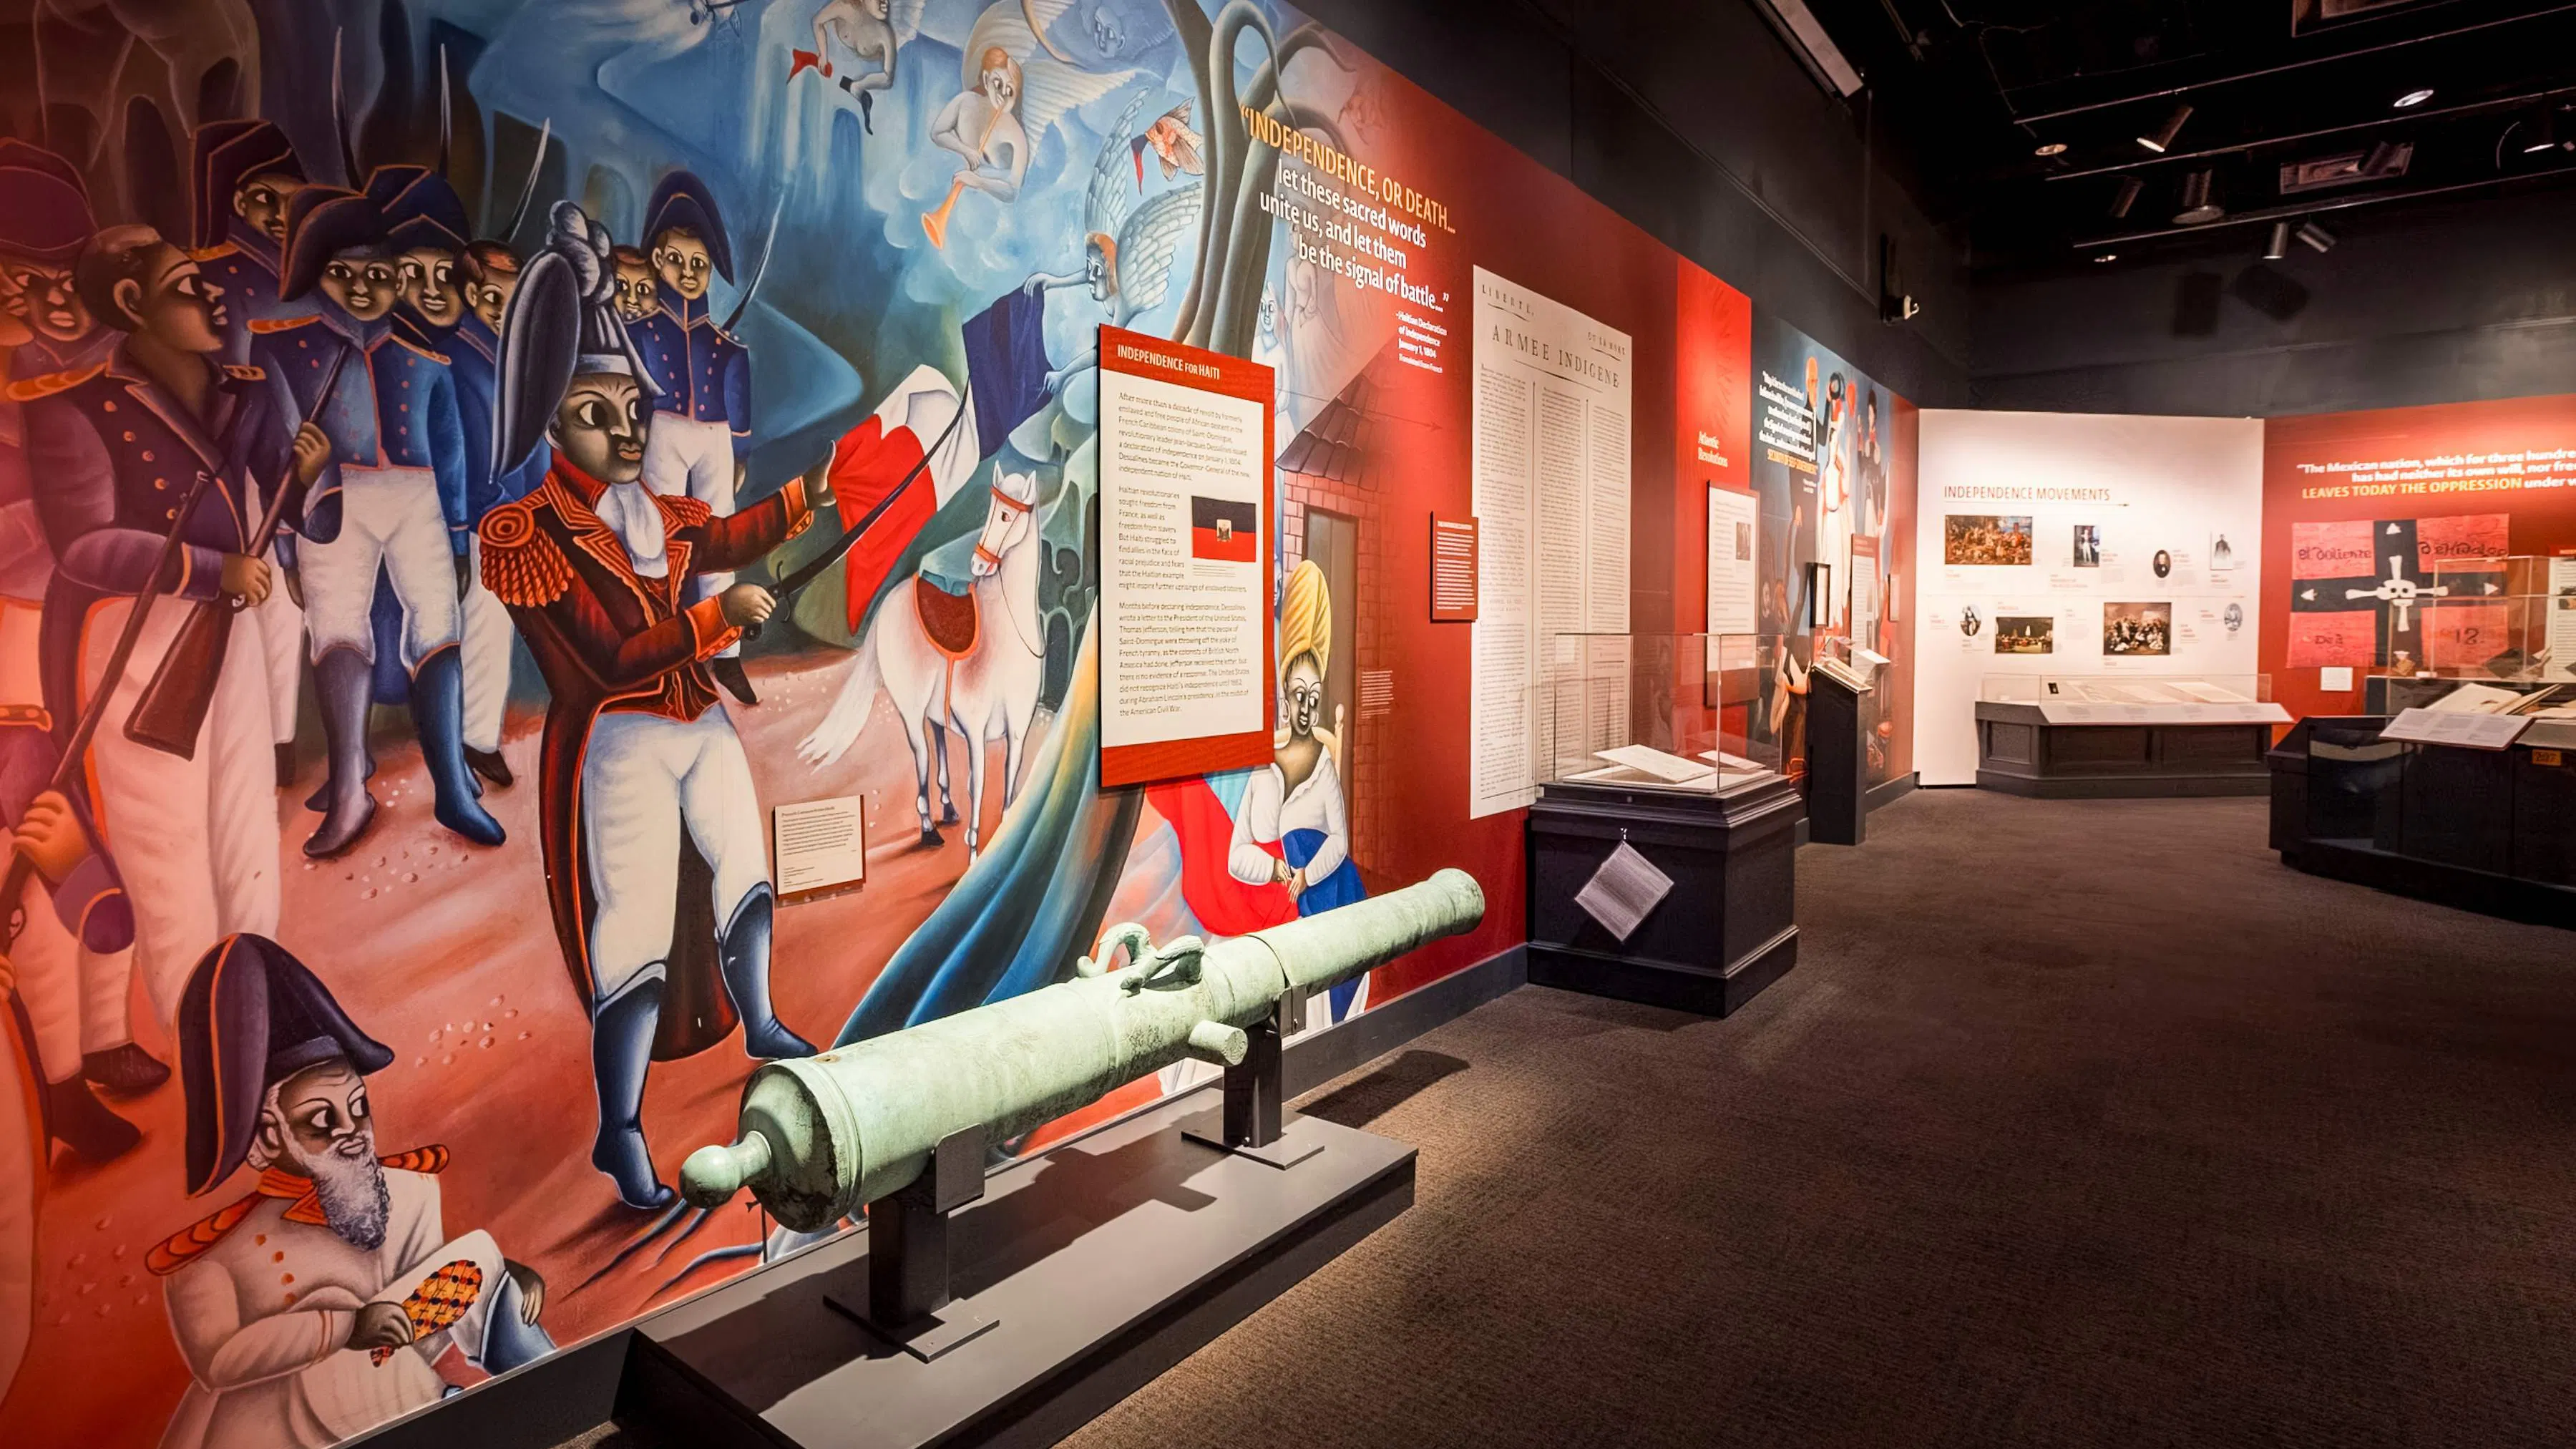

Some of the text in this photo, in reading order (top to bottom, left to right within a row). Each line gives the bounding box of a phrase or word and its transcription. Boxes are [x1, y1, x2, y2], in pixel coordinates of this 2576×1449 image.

[1279, 158, 1427, 248] let these sacred words
[1382, 177, 1403, 209] OR
[1260, 191, 1407, 269] unite us, and let them
[1299, 233, 1317, 264] be
[1319, 245, 1342, 274] the
[1345, 255, 1384, 289] signal
[1385, 273, 1400, 296] of
[1397, 325, 1440, 347] of Independence
[1117, 344, 1220, 380] INDEPENDENCE FOR HAITI
[1697, 447, 1728, 467] Revolutions
[2326, 461, 2379, 473] Mexican
[2379, 458, 2424, 469] nation,
[2424, 455, 2464, 467] which
[2466, 454, 2486, 464] for
[2487, 452, 2524, 463] three
[2351, 472, 2373, 482] has
[2374, 470, 2398, 482] had
[2399, 468, 2445, 480] neither
[2447, 467, 2463, 477] its
[2464, 467, 2495, 477] own
[2497, 462, 2525, 475] will,
[2527, 463, 2551, 473] nor
[1943, 485, 2110, 501] INDEPENDENCE MOVEMENTS
[2302, 487, 2350, 499] LEAVES
[2351, 484, 2397, 497] TODAY
[2401, 482, 2427, 494] THE
[2429, 477, 2522, 493] OPPRESSION
[2524, 476, 2565, 488] under
